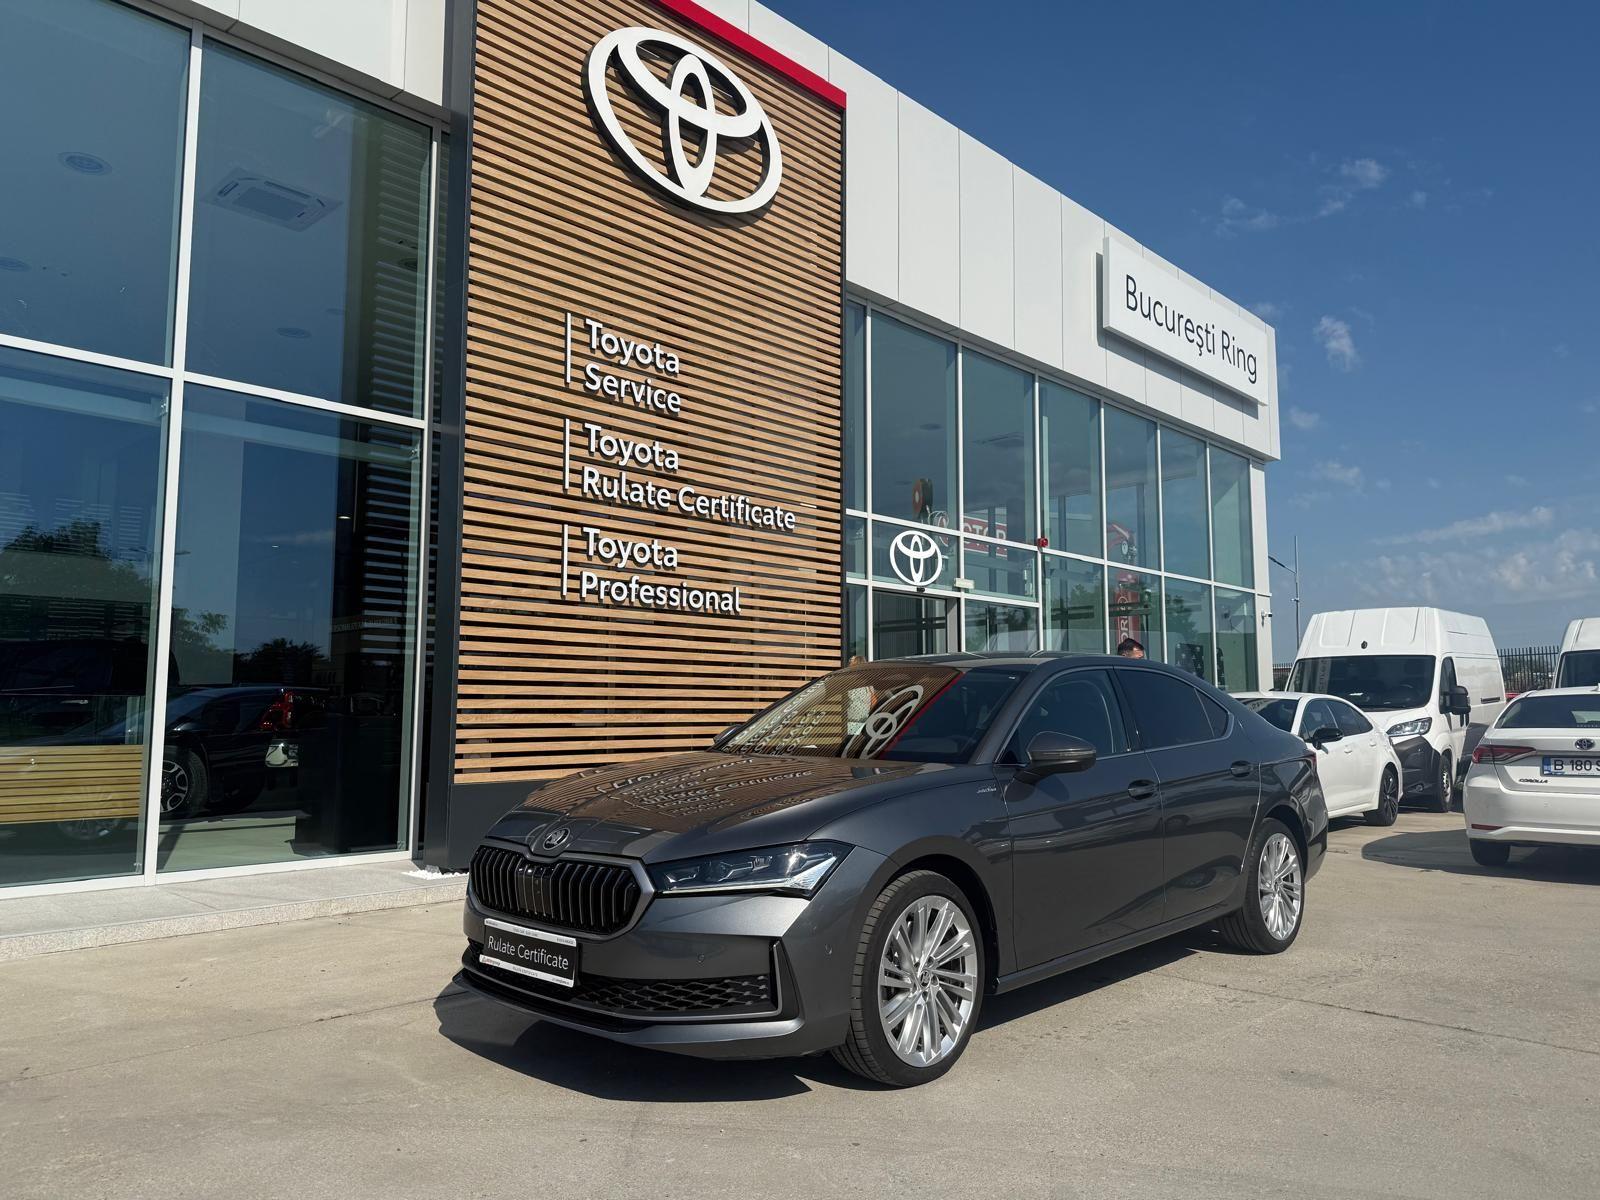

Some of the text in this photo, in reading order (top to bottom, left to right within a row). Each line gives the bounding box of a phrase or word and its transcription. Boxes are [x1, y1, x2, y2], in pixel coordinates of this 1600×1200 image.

[585, 318, 680, 375] Toyota
[1221, 330, 1258, 385] Ring
[584, 363, 682, 414] Service
[584, 422, 680, 471] Toyota
[582, 466, 797, 530] Rulate Certificate
[582, 526, 679, 569] Toyota
[581, 570, 742, 613] Professional
[1554, 759, 1564, 771] B
[1570, 759, 1592, 771] 180
[487, 935, 516, 956] Rulate
[517, 944, 569, 970] Certificate
